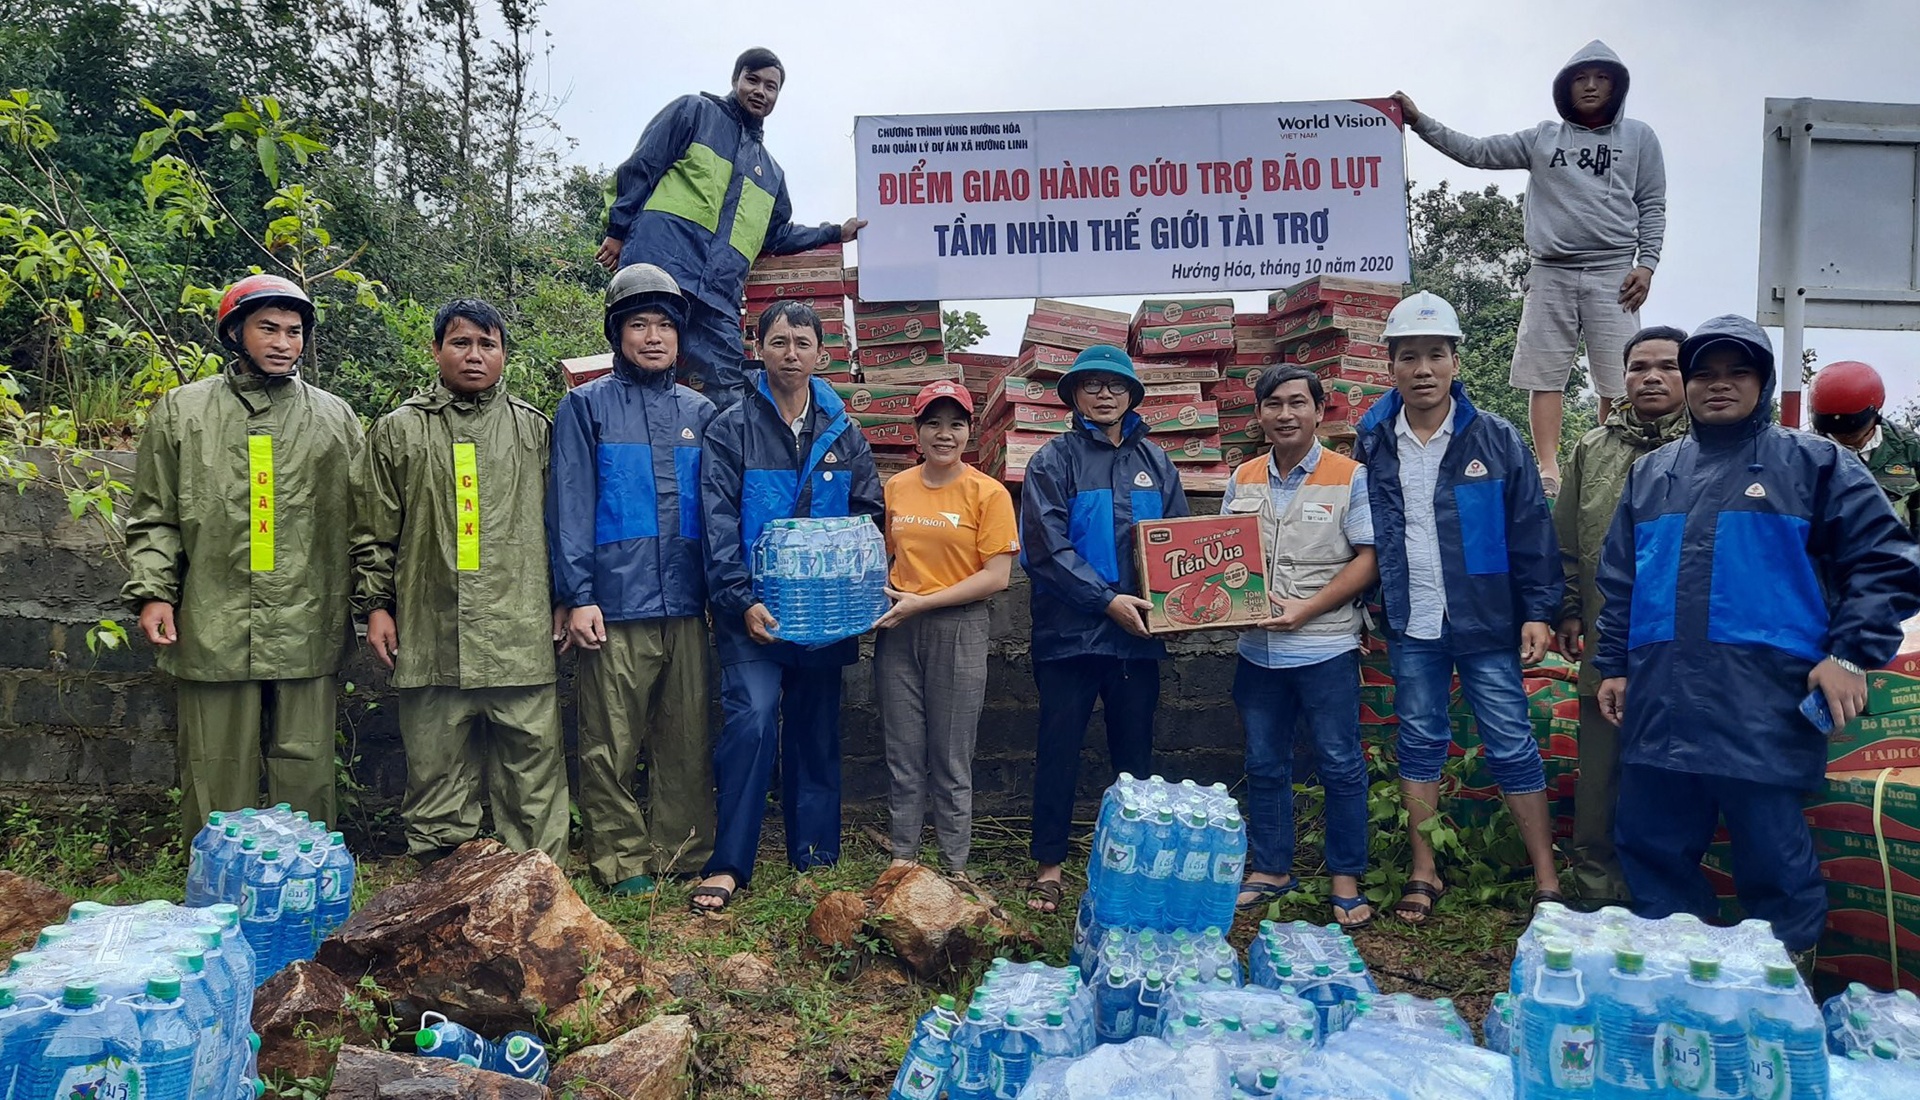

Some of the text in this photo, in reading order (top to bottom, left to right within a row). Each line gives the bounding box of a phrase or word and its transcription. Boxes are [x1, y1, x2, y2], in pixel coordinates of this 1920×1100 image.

[877, 121, 1021, 138] CHƯƠNG TRÌNH VÙNG HƯỚNG HÓA
[1278, 113, 1387, 130] World Vision
[871, 138, 1028, 155] BAN QUẢN LÝ DỰ ÁN XÃ HƯỚNG LINH
[878, 152, 1382, 205] ĐIỂM GIAO HÀNG CỨU TRỢ BÃO LỤT
[933, 207, 1330, 257] TẦM NHÌN THẾ GIỚI TÀI TRỢ
[1171, 255, 1394, 282] Hướng Hóa, tháng 10 năm 2020
[917, 515, 947, 528] Vision
[1881, 717, 1906, 728] Rau
[1861, 746, 1920, 762] TADIC
